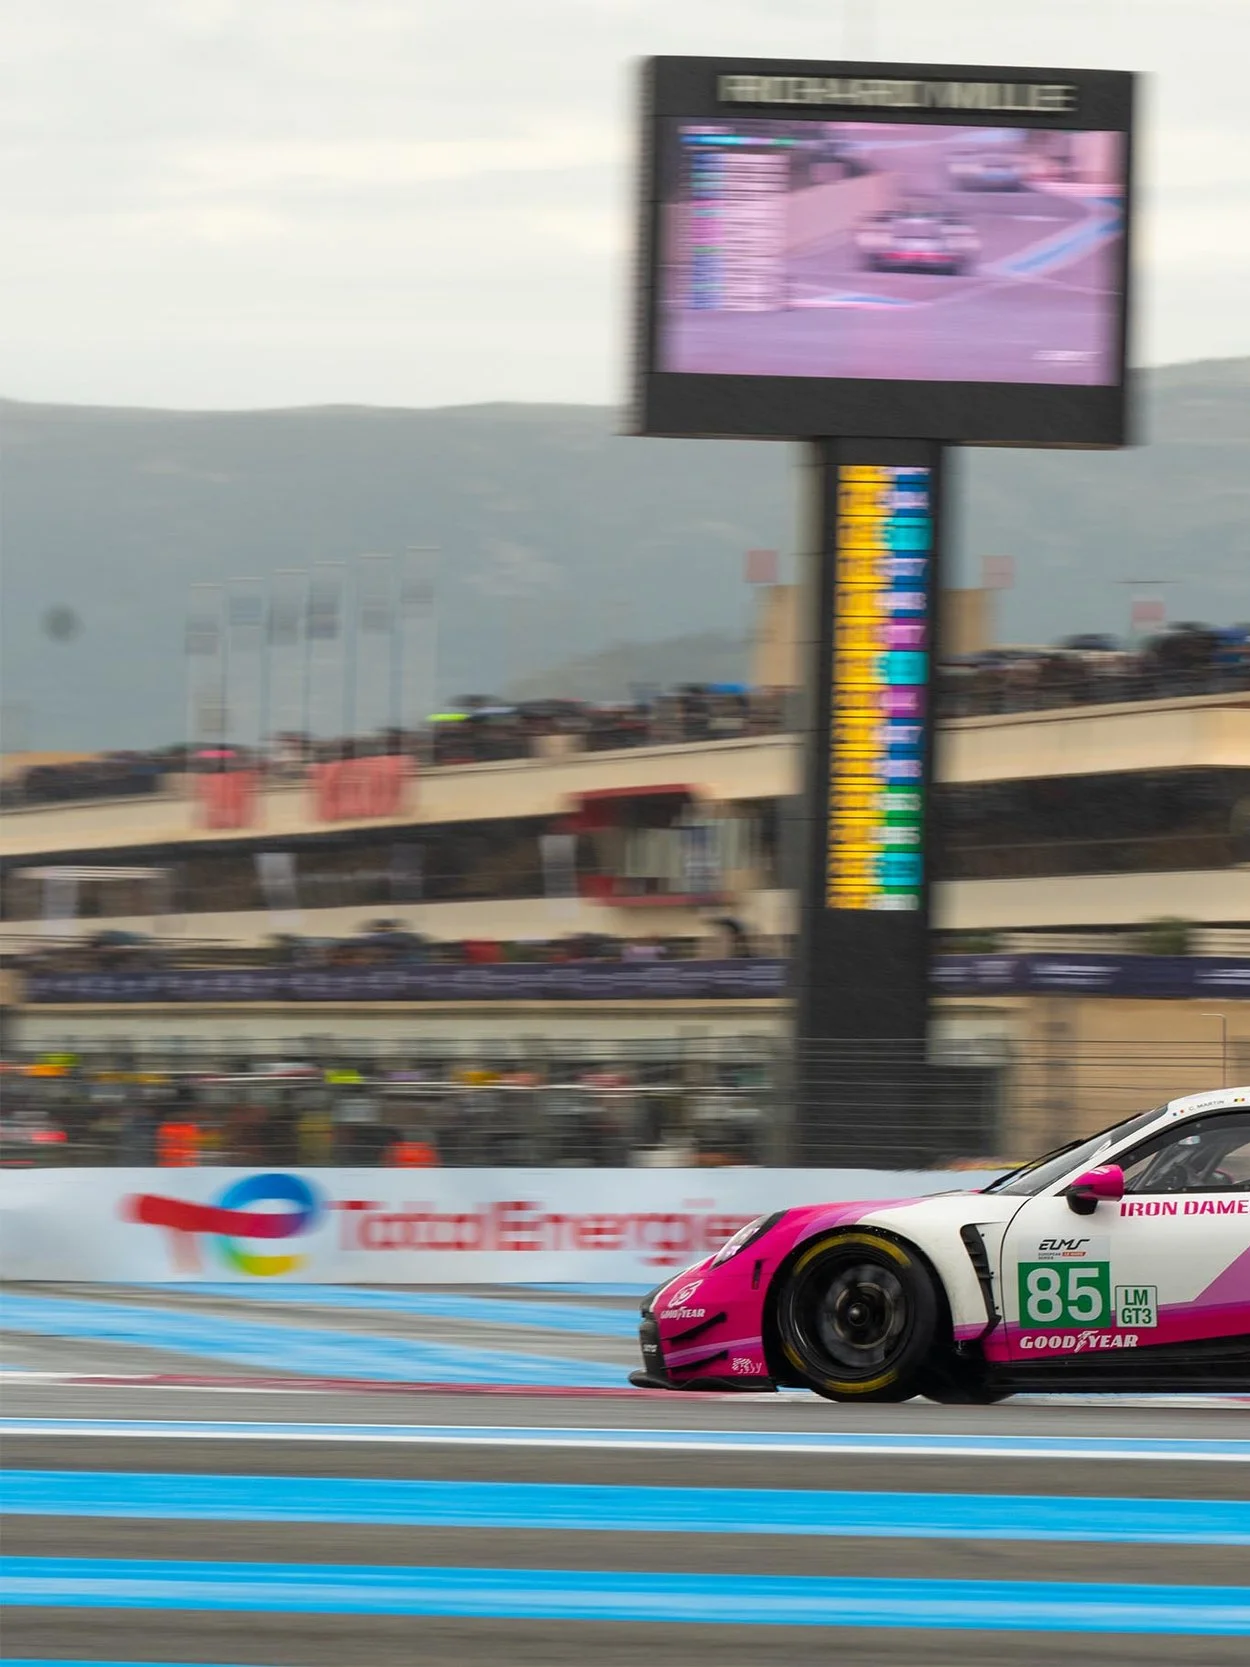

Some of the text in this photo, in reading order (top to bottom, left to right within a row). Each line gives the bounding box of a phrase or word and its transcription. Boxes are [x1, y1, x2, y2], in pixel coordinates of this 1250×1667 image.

[1120, 1201, 1178, 1217] IRON
[1039, 1239, 1091, 1250] ELMS
[1026, 1267, 1103, 1322] 85
[1124, 1289, 1148, 1306] LM
[660, 1306, 706, 1320] GOODYEAR
[1121, 1308, 1152, 1324] GT3
[1020, 1330, 1138, 1353] GOODYEAR
